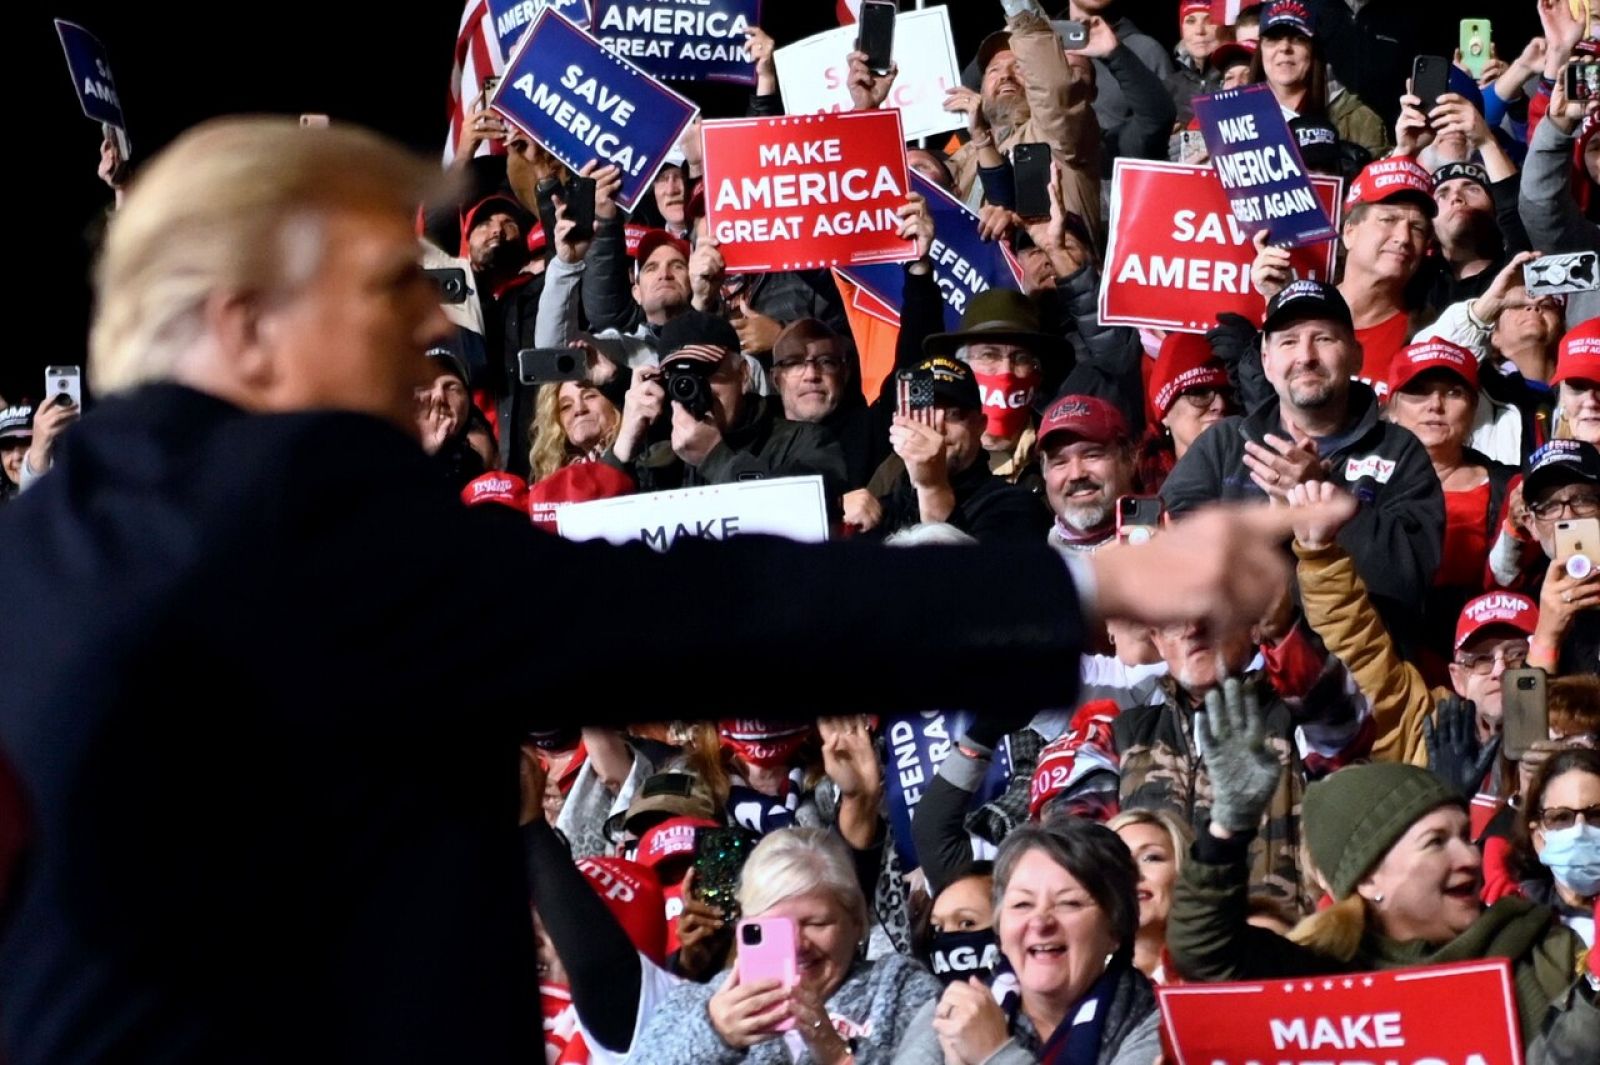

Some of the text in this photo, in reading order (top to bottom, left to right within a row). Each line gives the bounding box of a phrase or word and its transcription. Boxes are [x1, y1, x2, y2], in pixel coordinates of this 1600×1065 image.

[600, 4, 752, 40] AMERICA
[679, 42, 752, 64] AGAIN
[560, 64, 636, 127] SAVE
[512, 73, 648, 176] AMERICA!
[1217, 114, 1259, 145] MAKE
[759, 139, 842, 167] MAKE
[1215, 144, 1301, 189] AMERICA
[714, 165, 901, 211] AMERICA
[1264, 186, 1317, 220] AGAIN
[716, 207, 905, 244] GREAT AGAIN
[640, 516, 739, 549] MAKE
[1465, 595, 1529, 620] TRUMP
[1269, 1011, 1405, 1050] MAKE
